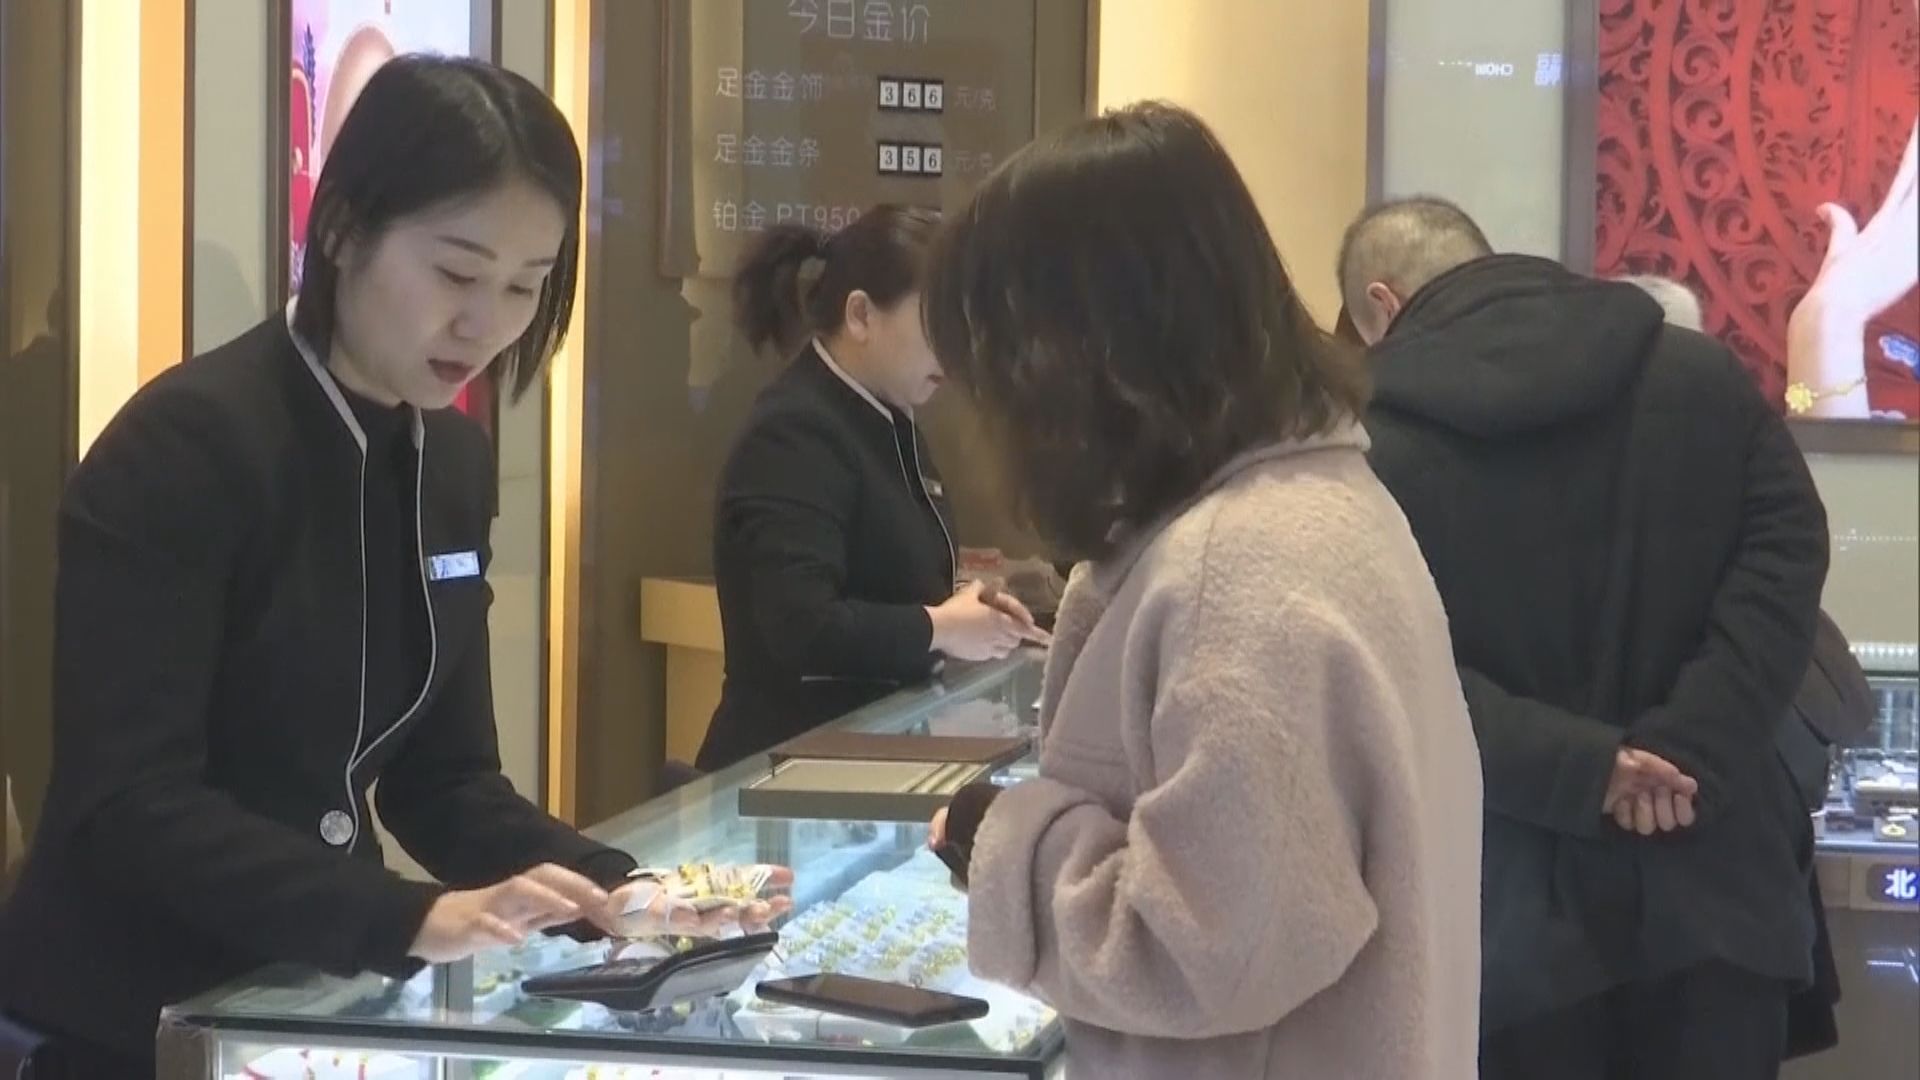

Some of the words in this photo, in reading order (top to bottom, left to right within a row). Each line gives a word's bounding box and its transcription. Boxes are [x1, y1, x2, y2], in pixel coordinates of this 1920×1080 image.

[787, 0, 930, 42] 今日金价
[714, 67, 823, 100] 足金金饰
[882, 83, 940, 107] 366
[714, 134, 819, 168] 足金金条
[882, 148, 940, 170] 356
[712, 200, 766, 232] 铂金
[1885, 868, 1917, 898] 北
